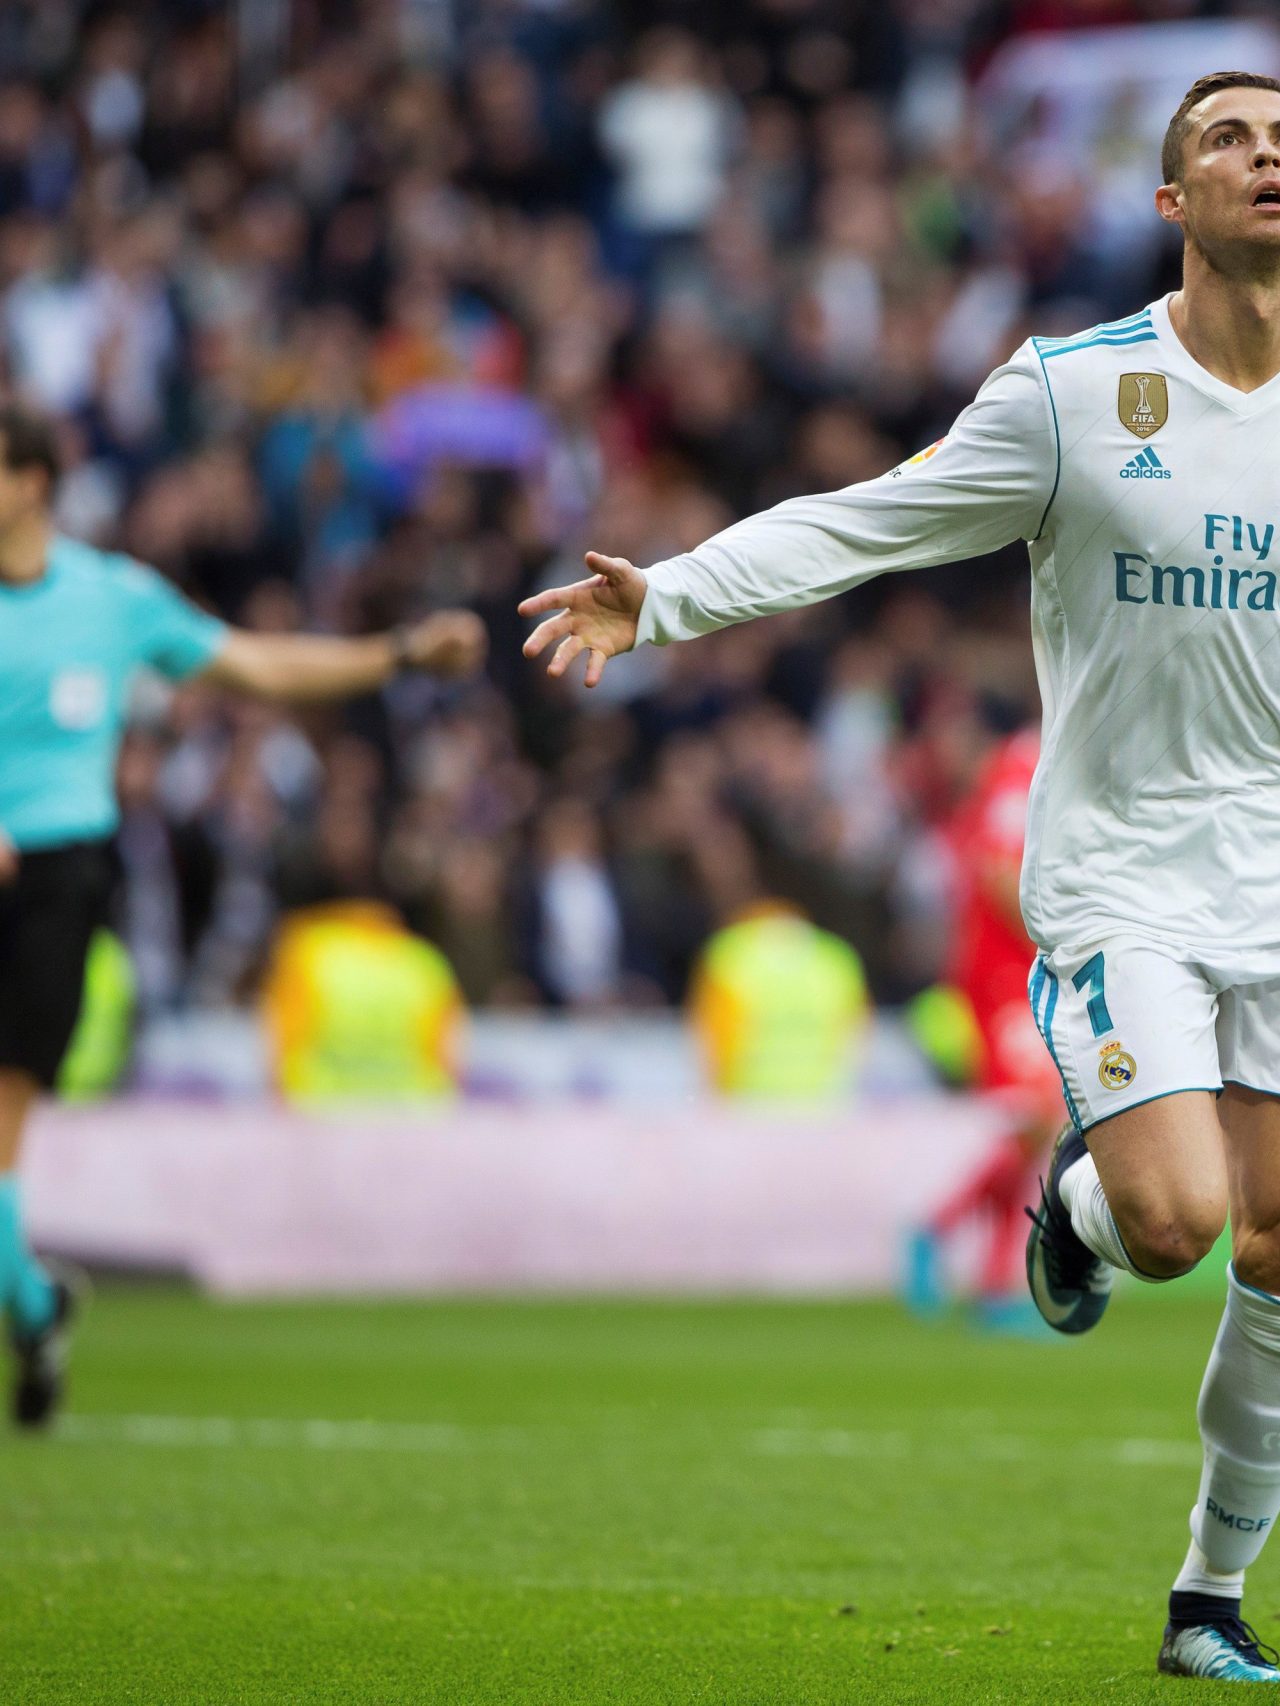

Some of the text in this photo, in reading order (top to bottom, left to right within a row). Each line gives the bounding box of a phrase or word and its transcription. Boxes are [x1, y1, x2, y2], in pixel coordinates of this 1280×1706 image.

[1132, 414, 1155, 423] FIFA
[1119, 466, 1172, 479] adidas
[1203, 513, 1275, 560] Fly
[1206, 1496, 1271, 1532] RMCF
